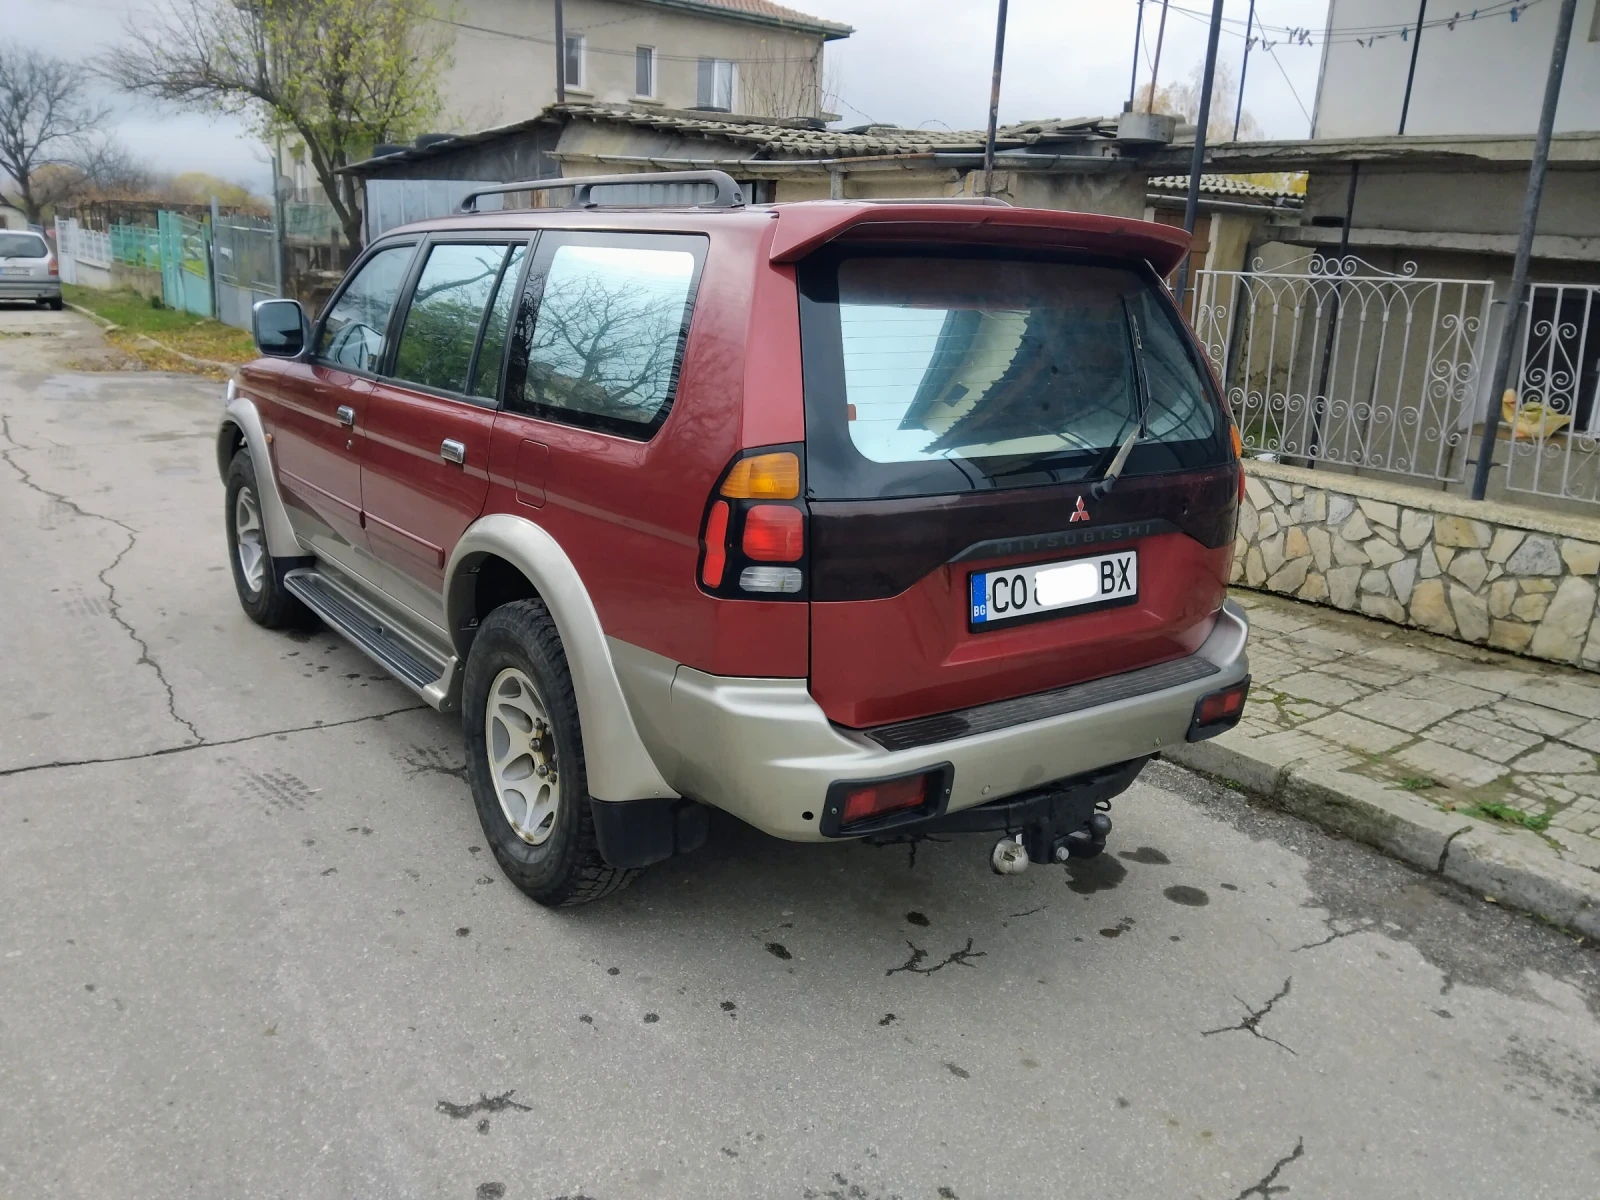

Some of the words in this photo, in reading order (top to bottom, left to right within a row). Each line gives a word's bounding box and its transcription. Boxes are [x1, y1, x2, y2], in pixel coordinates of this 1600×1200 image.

[996, 524, 1150, 553] MITSUBISHI
[992, 574, 1028, 613] CO
[1100, 557, 1131, 595] BX
[973, 605, 986, 617] BG
